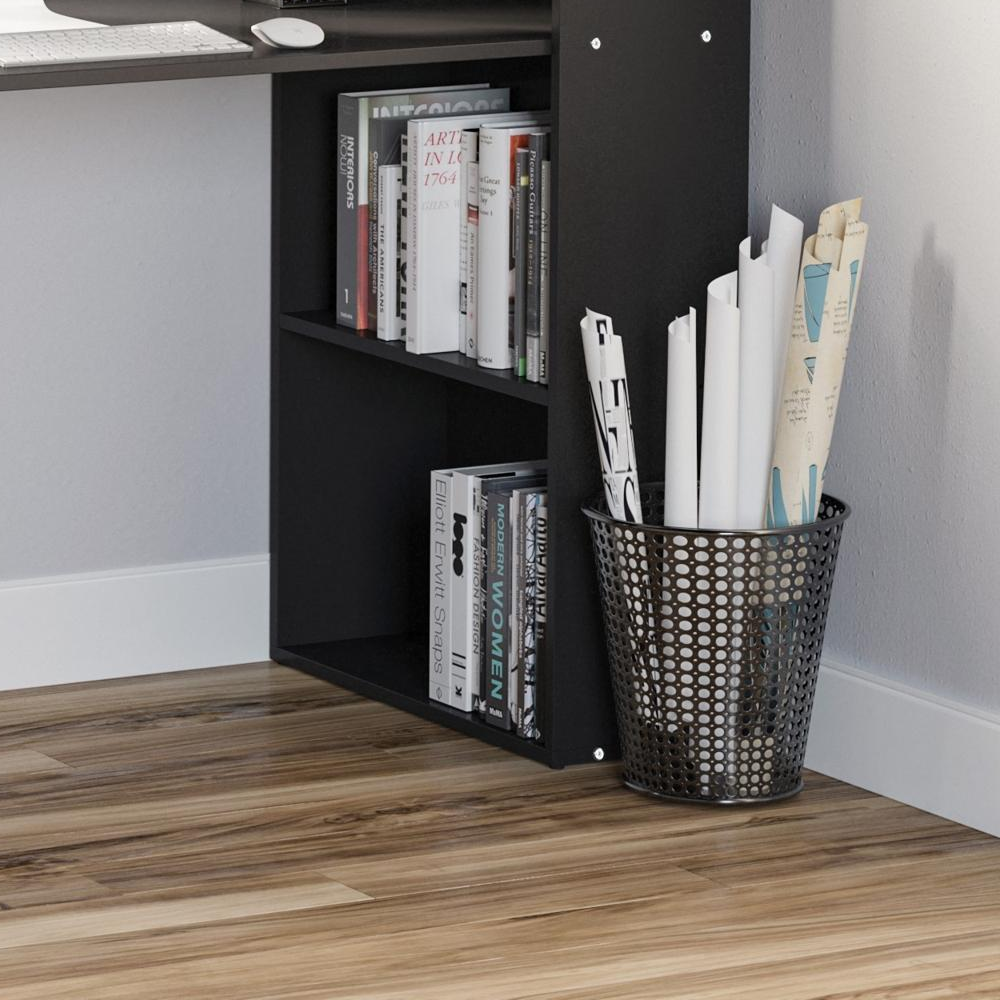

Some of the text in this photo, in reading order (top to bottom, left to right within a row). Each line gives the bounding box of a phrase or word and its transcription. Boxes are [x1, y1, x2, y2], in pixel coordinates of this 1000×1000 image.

[346, 136, 354, 209] INTERIORS
[424, 151, 446, 167] IN
[424, 173, 457, 187] 1764
[432, 478, 447, 674] Elliott Erwitt Snaps
[472, 536, 480, 598] FASHION
[496, 503, 504, 576] MODERN
[491, 580, 504, 700] WOMEN
